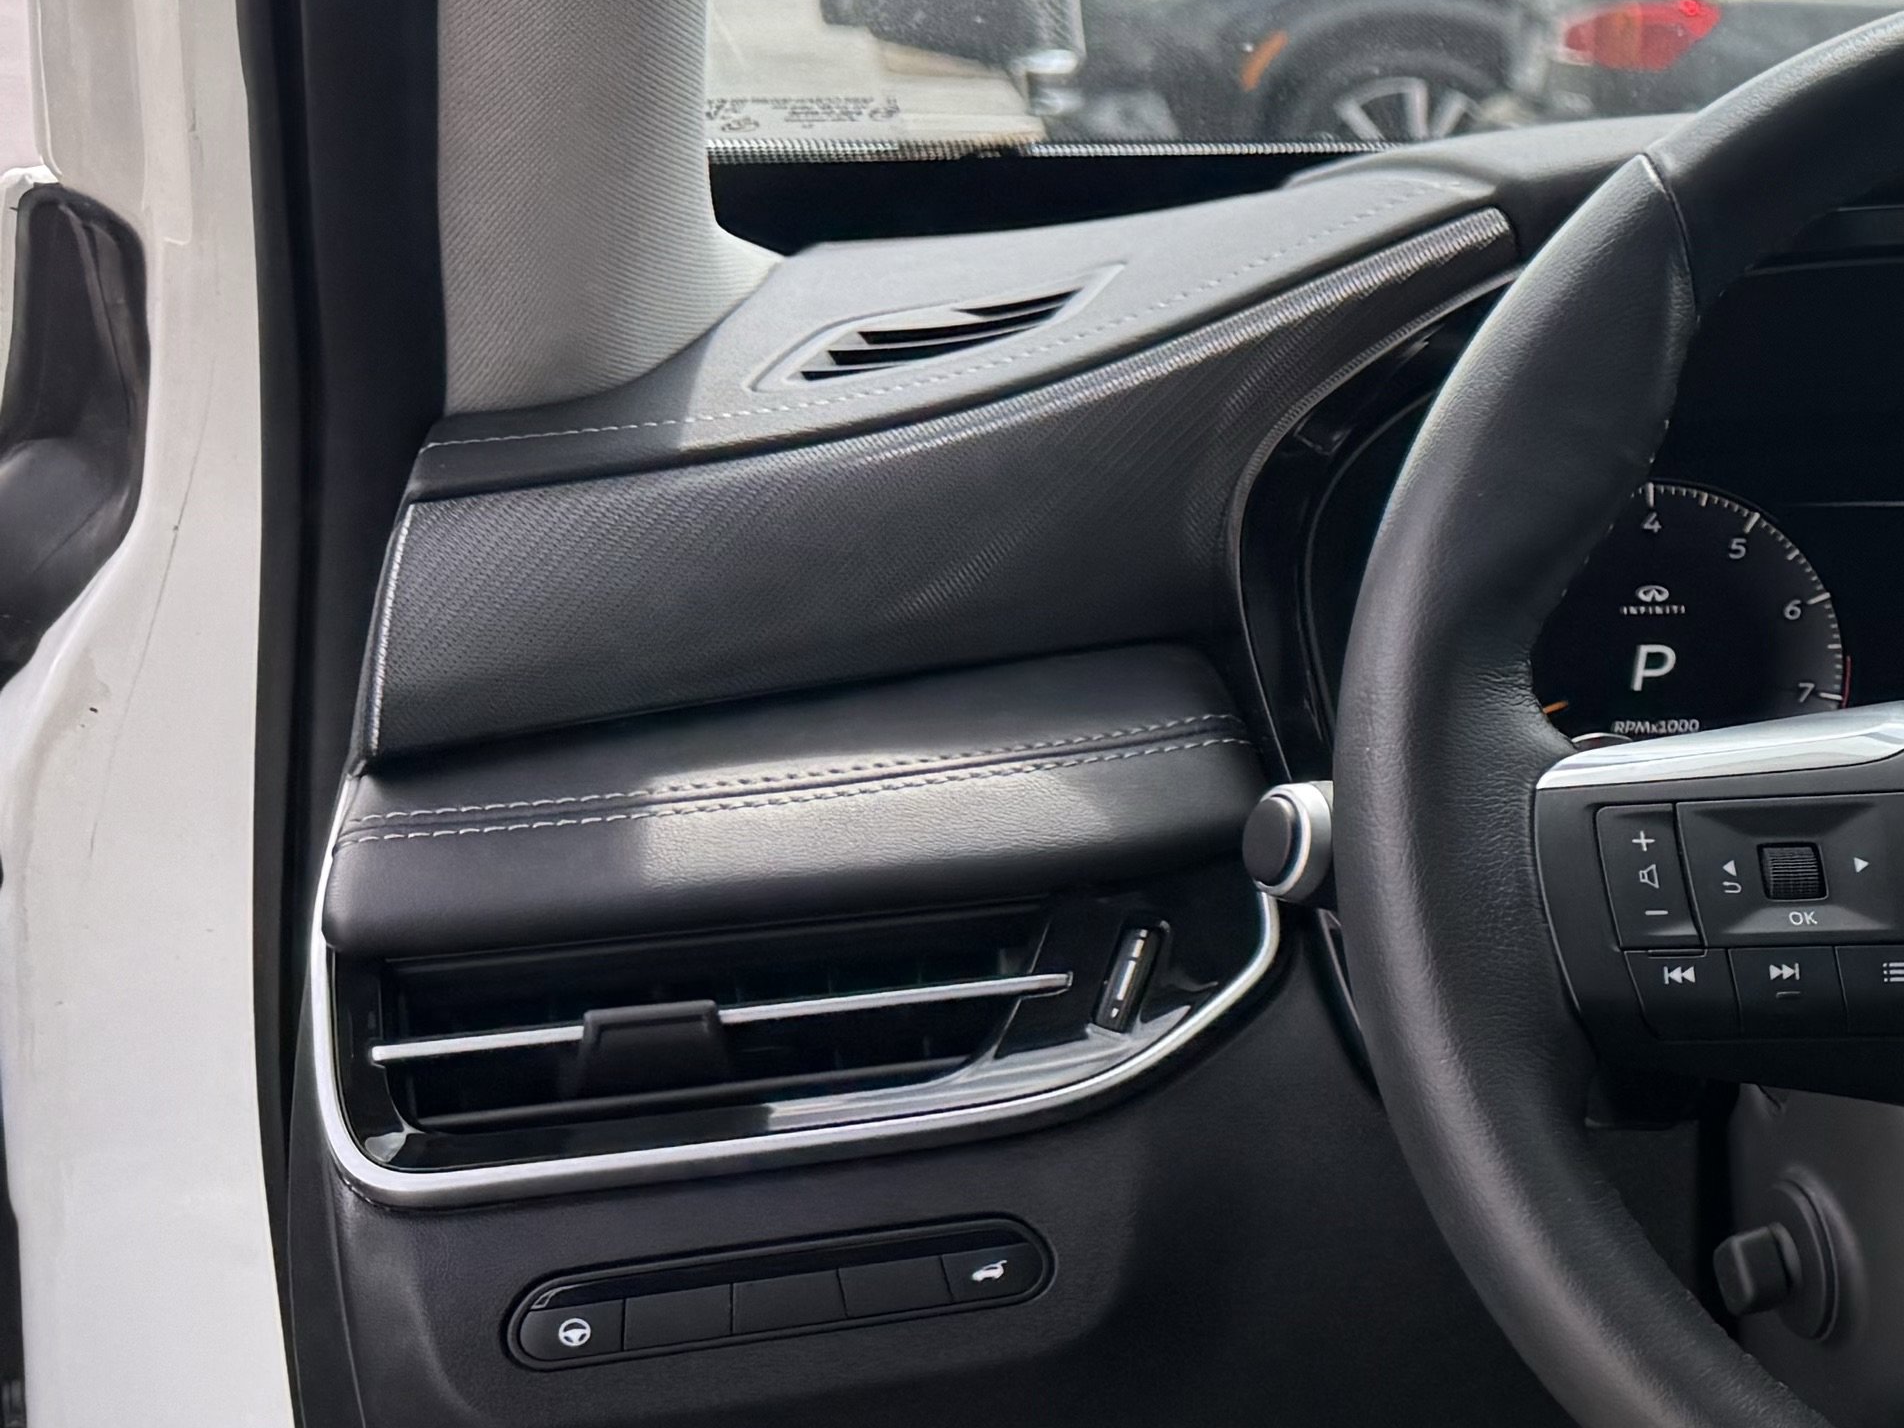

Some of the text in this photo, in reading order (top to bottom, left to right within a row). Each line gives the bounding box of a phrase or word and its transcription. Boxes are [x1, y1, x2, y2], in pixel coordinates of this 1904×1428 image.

[1641, 512, 1662, 534] 4
[1728, 537, 1748, 560] 5
[1783, 598, 1802, 621] 6
[1631, 644, 1677, 692] P
[1797, 682, 1816, 703] 7
[1788, 910, 1819, 926] OK
